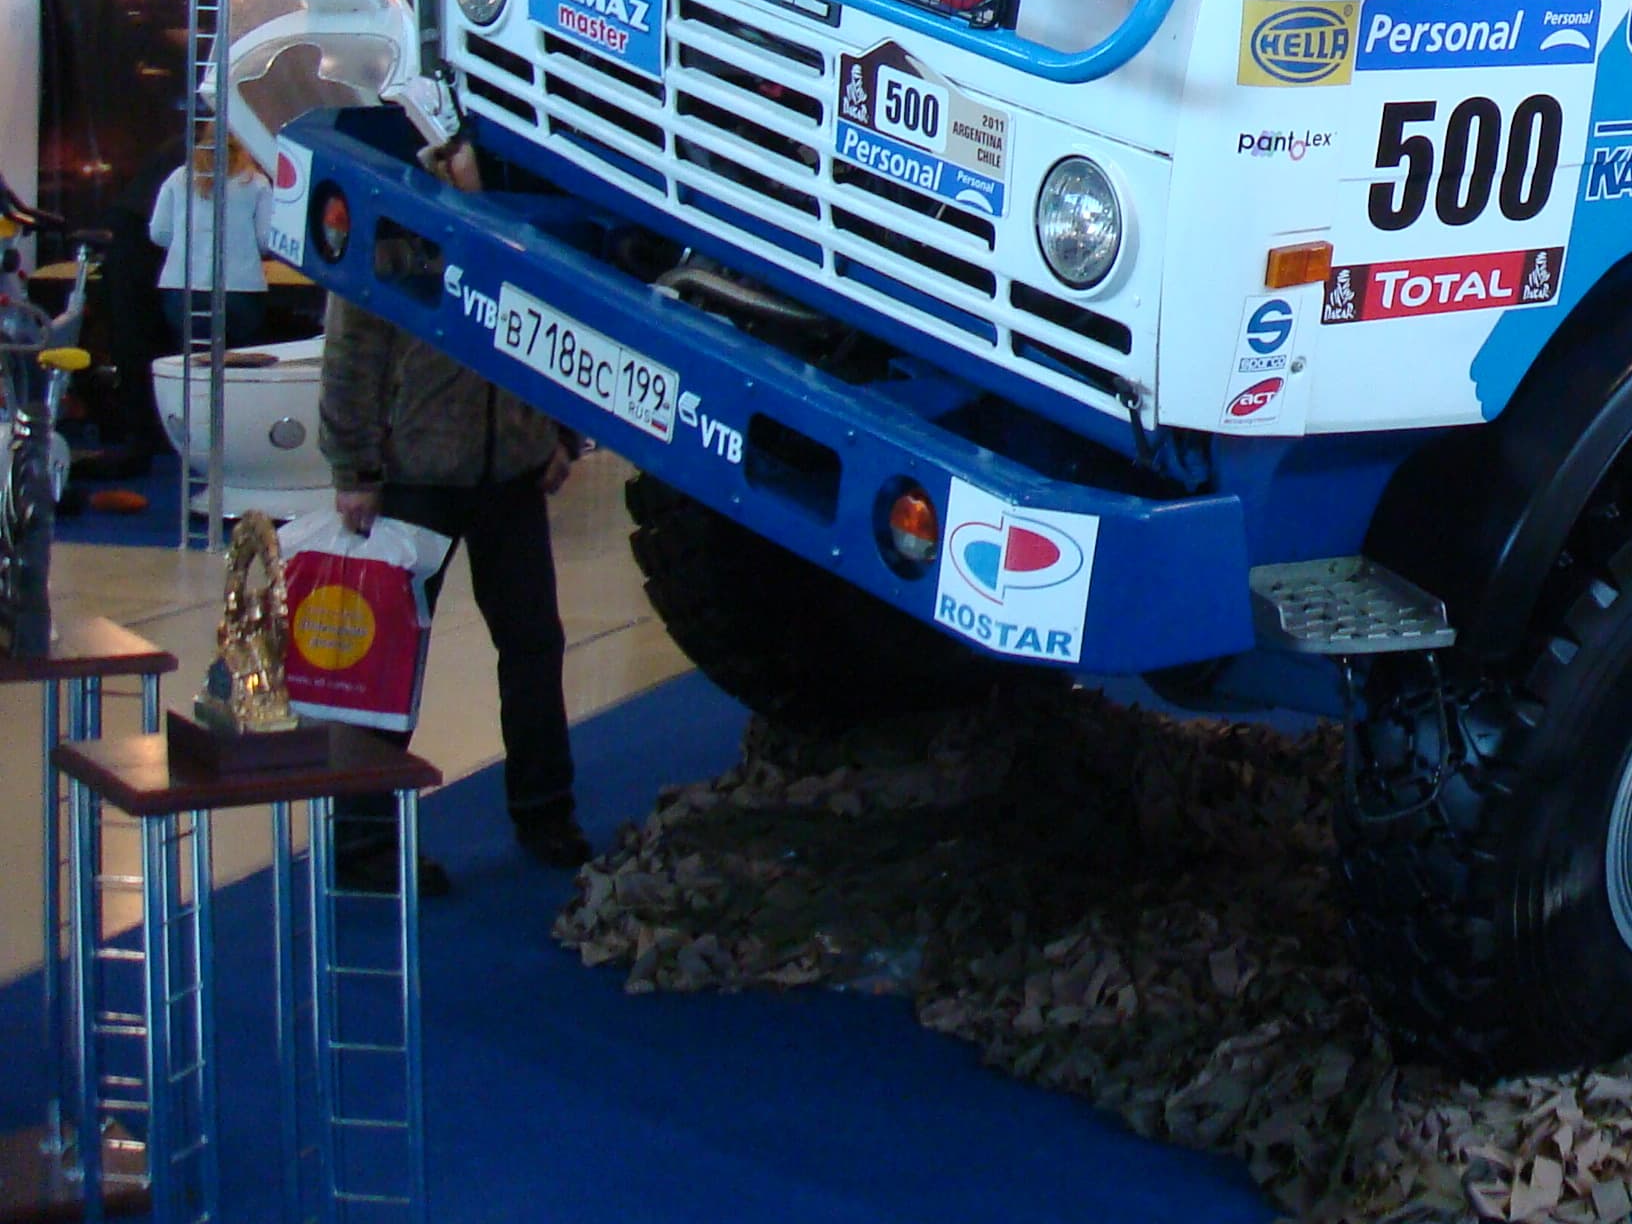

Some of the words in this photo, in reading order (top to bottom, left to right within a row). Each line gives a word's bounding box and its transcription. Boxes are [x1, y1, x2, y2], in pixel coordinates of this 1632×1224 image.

[558, 2, 629, 53] master
[1257, 26, 1350, 62] HELLA
[1363, 9, 1525, 54] Personal
[1543, 9, 1594, 26] Personal
[884, 78, 940, 139] 500
[981, 114, 1005, 133] 2011
[951, 121, 1003, 152] ARGENTINA
[976, 147, 1002, 169] CHILE
[842, 127, 944, 192] Personal
[956, 169, 995, 195] Personal
[1367, 93, 1564, 232] 500
[462, 284, 499, 331] VTB
[1374, 269, 1513, 310] TOTAL
[623, 359, 668, 413] 199
[627, 400, 652, 424] RUS
[700, 412, 744, 465] VTB
[937, 592, 1074, 659] ROSTAR
